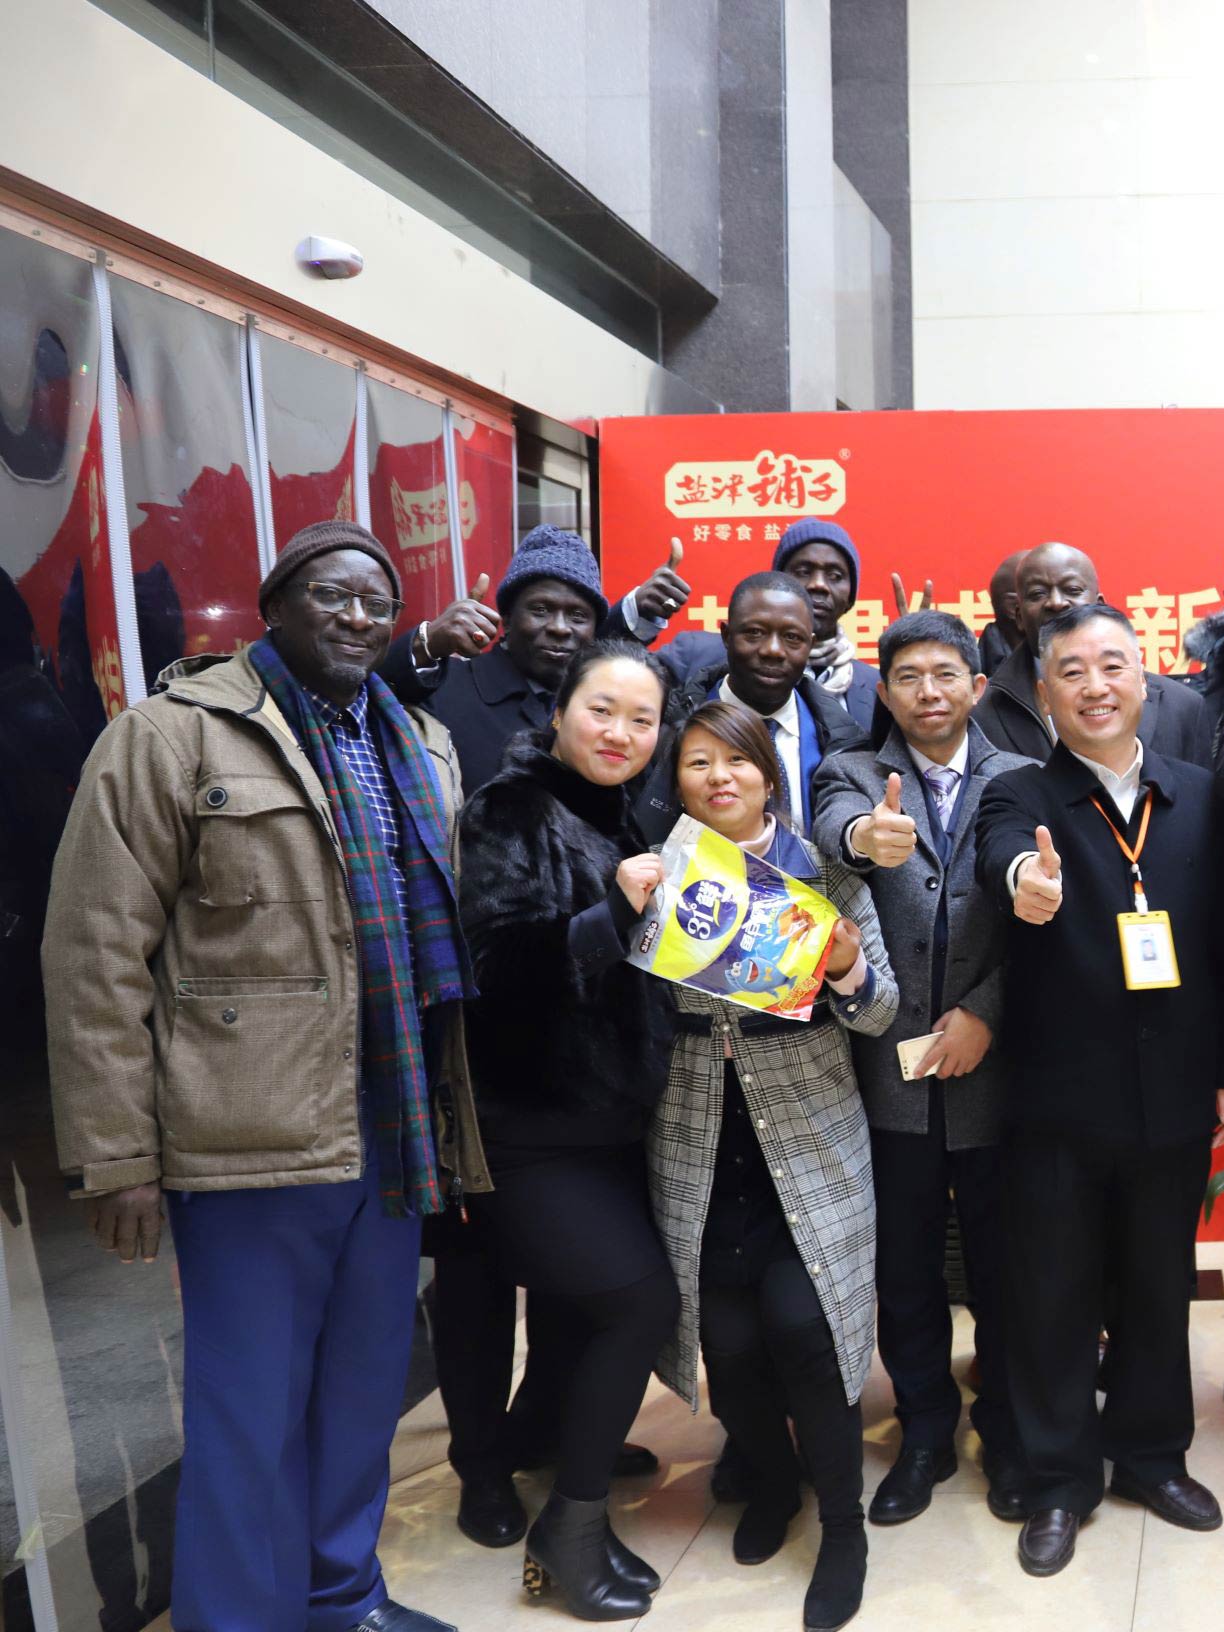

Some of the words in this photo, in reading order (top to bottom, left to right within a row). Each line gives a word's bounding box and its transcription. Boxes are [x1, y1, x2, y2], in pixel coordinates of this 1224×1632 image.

[674, 456, 838, 509] 盐津铺子
[693, 524, 753, 542] 好零食
